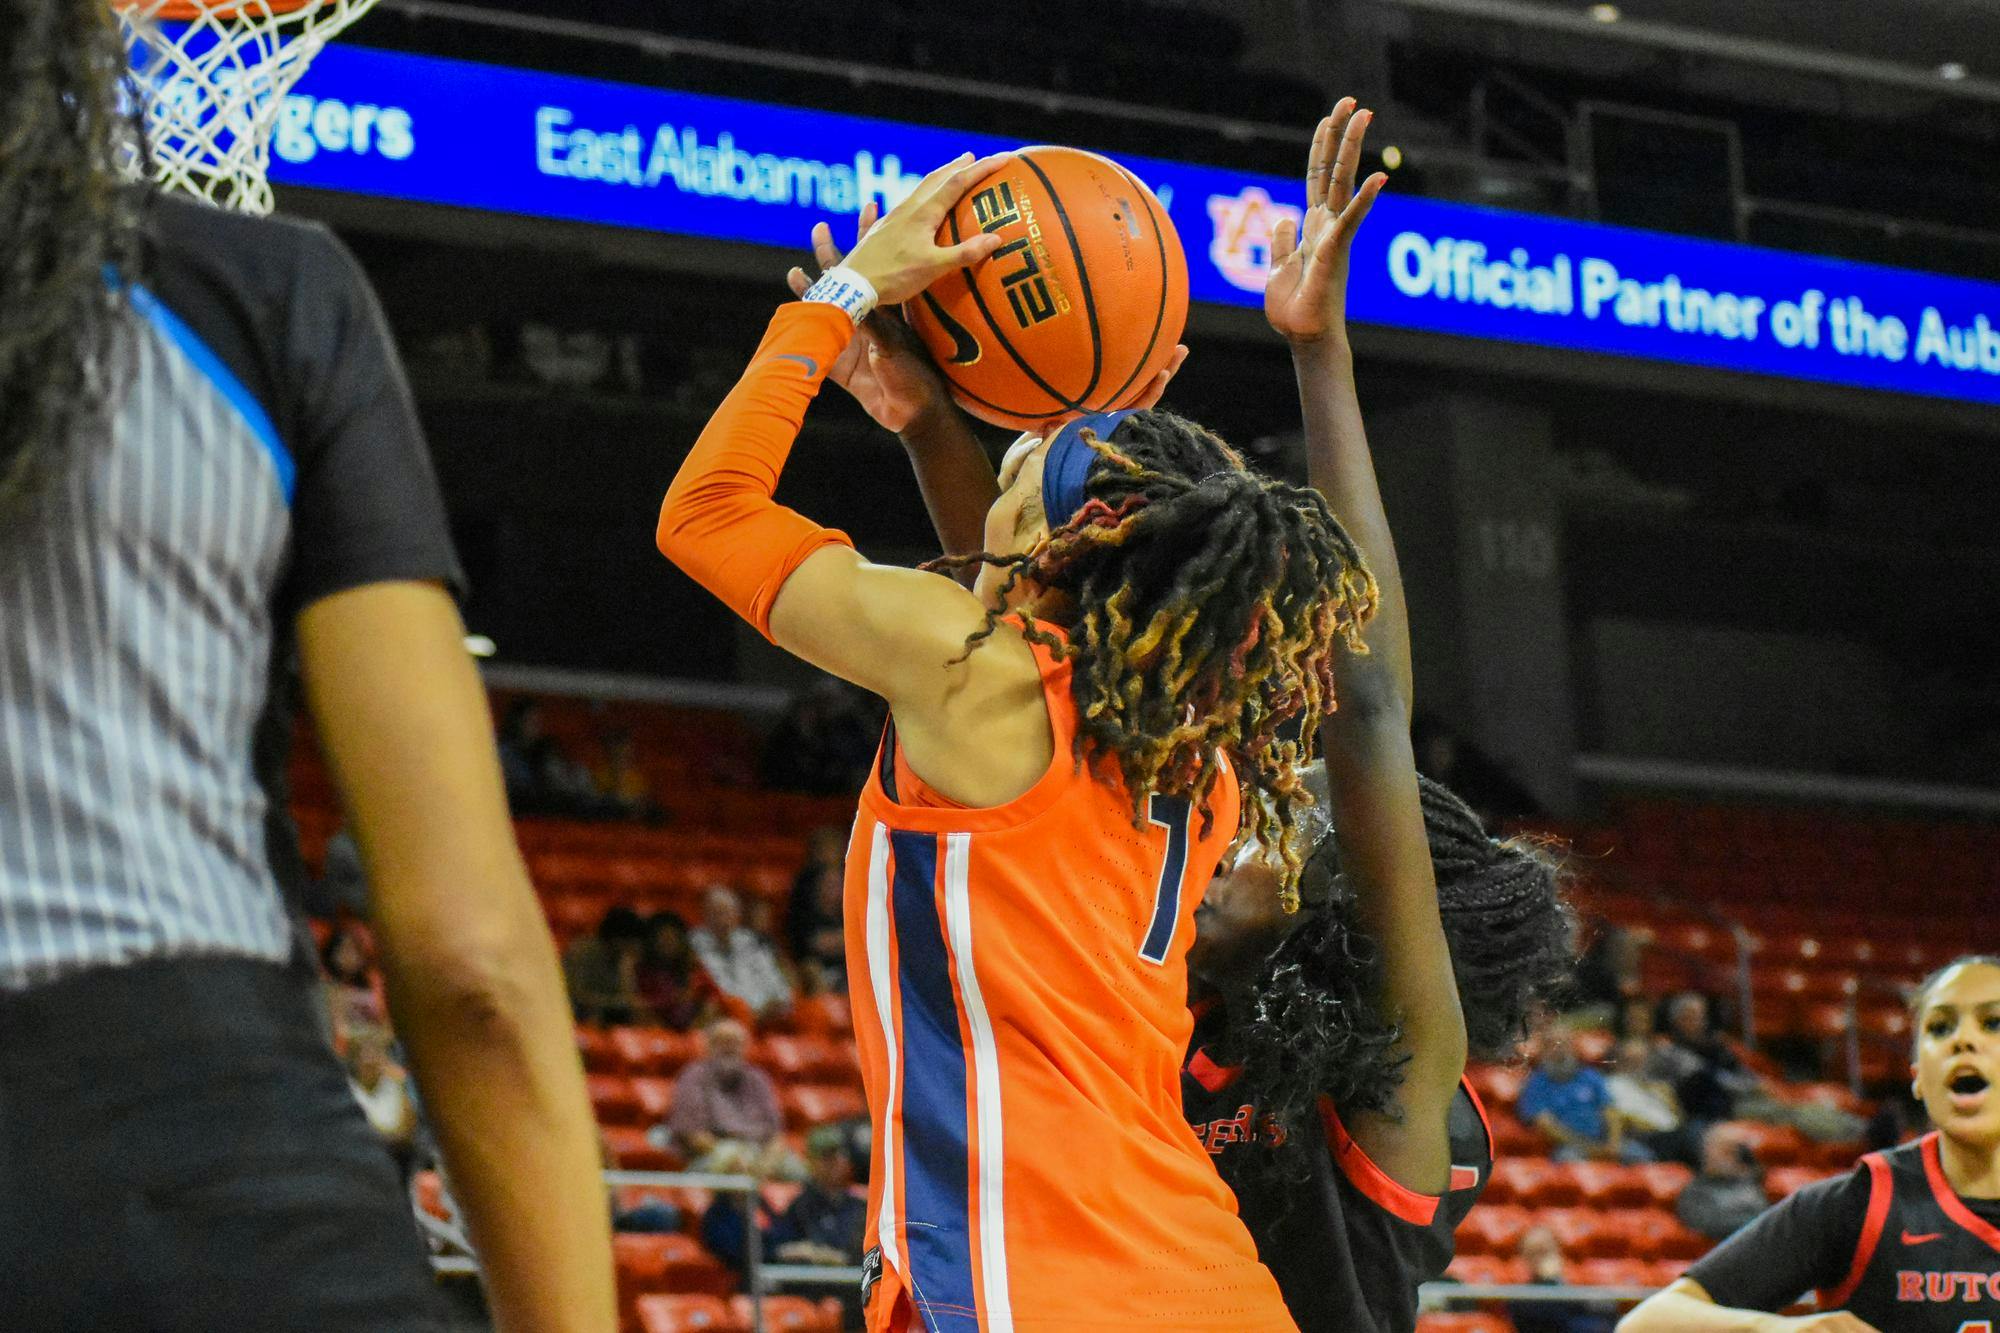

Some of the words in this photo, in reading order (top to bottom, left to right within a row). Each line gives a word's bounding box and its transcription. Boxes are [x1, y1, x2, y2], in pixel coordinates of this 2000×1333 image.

[1388, 231, 1574, 316] Official
[1580, 257, 1766, 342] Partner
[1770, 289, 1826, 350] of
[1829, 295, 1909, 363] the
[1138, 790, 1193, 966] 1
